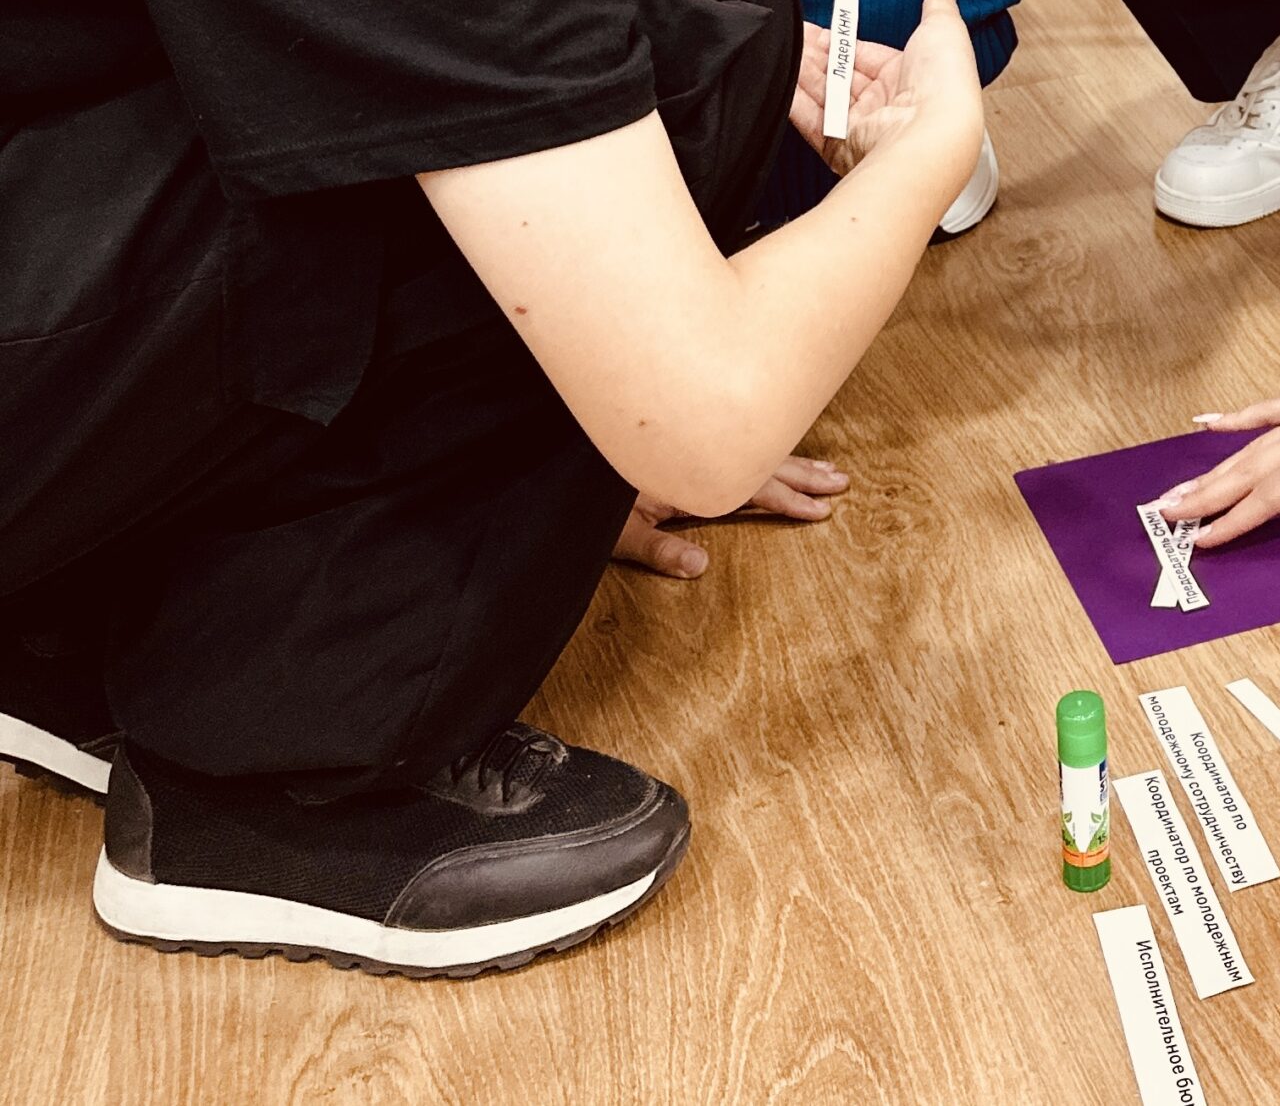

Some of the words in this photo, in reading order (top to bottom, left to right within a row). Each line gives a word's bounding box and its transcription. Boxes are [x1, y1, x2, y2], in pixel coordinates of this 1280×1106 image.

[833, 39, 852, 80] Лидер
[838, 9, 852, 36] КНМ
[1161, 537, 1201, 604] Председатель
[1148, 695, 1196, 781] молодежному
[1189, 782, 1248, 885] сотрудничеству
[1190, 732, 1238, 813] Координатор
[1232, 813, 1247, 831] по
[1145, 776, 1190, 864] Координатор
[1183, 866, 1198, 884] по
[1191, 885, 1243, 983] молодежным
[1148, 849, 1184, 916] проектам
[1136, 940, 1185, 1075] Исполнительное
